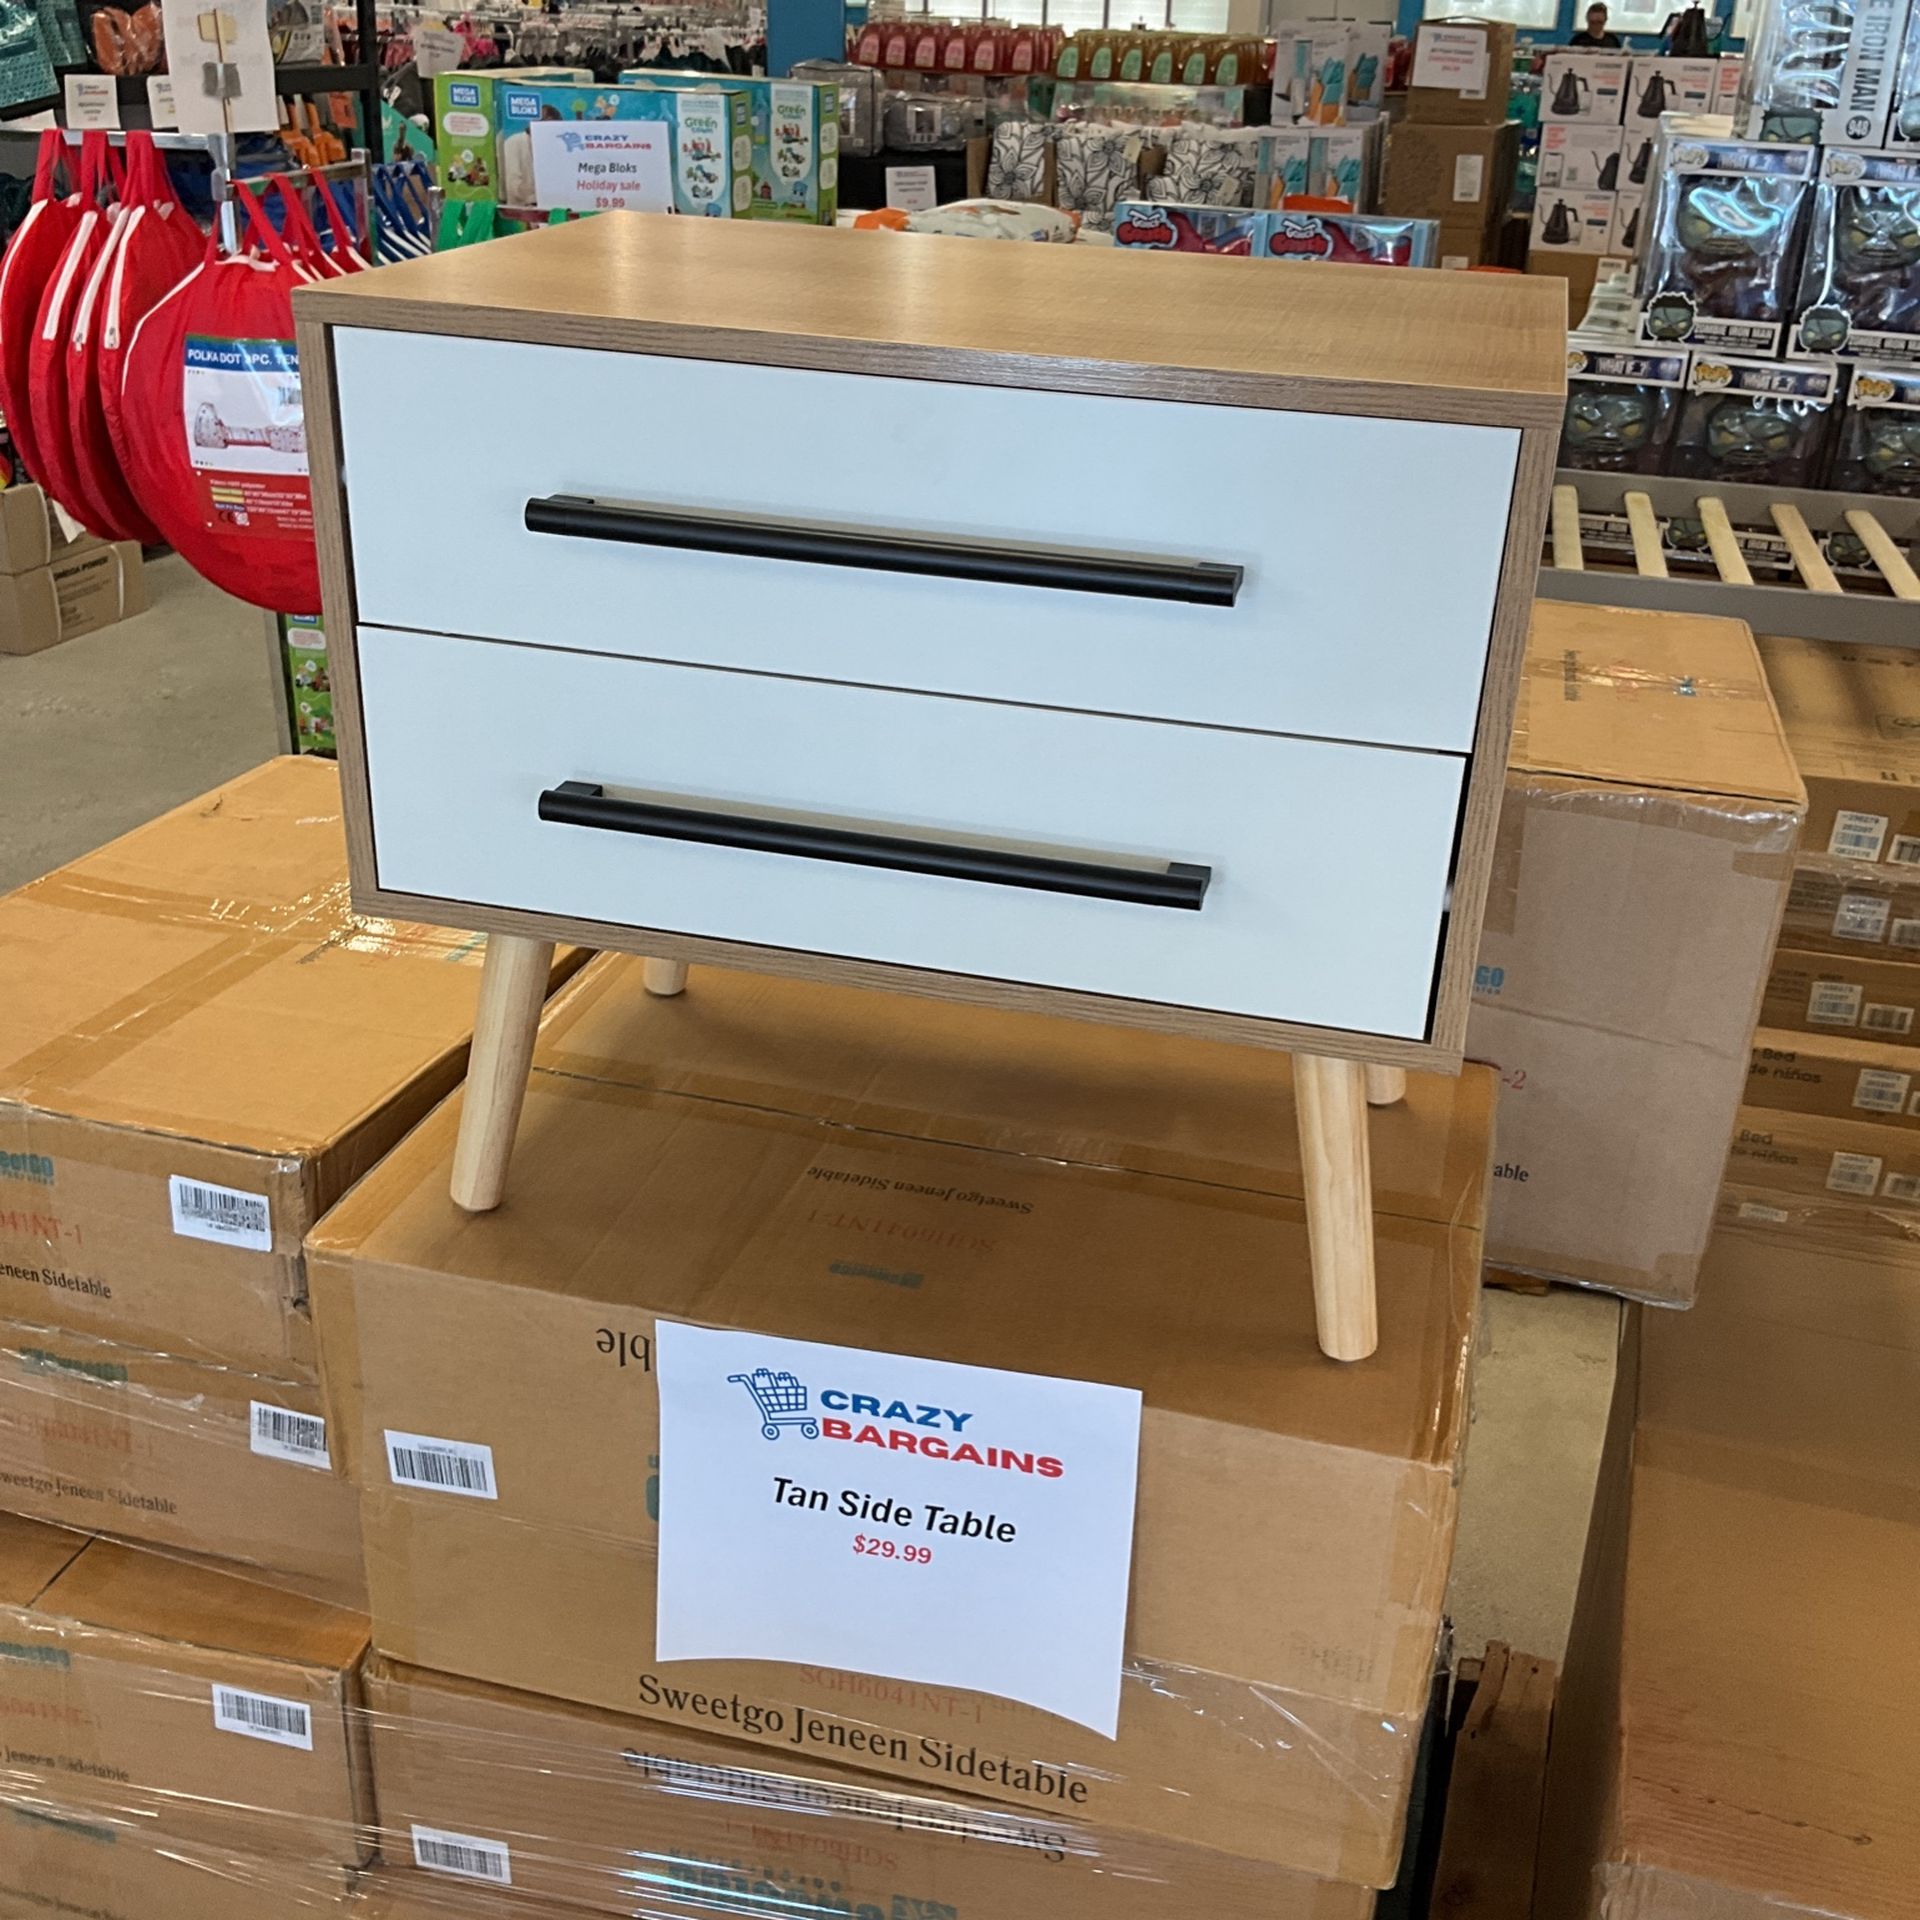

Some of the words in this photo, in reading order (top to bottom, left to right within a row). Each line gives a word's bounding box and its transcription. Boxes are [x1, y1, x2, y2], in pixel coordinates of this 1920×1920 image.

[1859, 15, 1890, 62] IRON
[1849, 68, 1882, 112] MAN
[584, 134, 629, 142] CRAZY
[1848, 119, 1870, 137] 948
[584, 142, 653, 151] BARGAINS
[577, 162, 607, 175] Mega
[608, 161, 638, 174] Bloks
[576, 180, 617, 193] Holiday
[619, 180, 641, 192] sale
[595, 197, 626, 209] $9.99
[186, 348, 219, 363] POLKA
[219, 352, 242, 365] DOT
[806, 1166, 890, 1192] Sidetable
[41, 1267, 112, 1300] Sidetable
[820, 1389, 974, 1433] CRAZY
[822, 1417, 1064, 1478] BARGAINS
[773, 1476, 829, 1512] Tan
[838, 1489, 913, 1527] Side
[924, 1504, 1017, 1543] Table
[852, 1532, 933, 1565] $29.99
[638, 1673, 784, 1735] Sweetgo
[789, 1706, 908, 1761] Jeneen
[918, 1736, 1089, 1804] Sidetable
